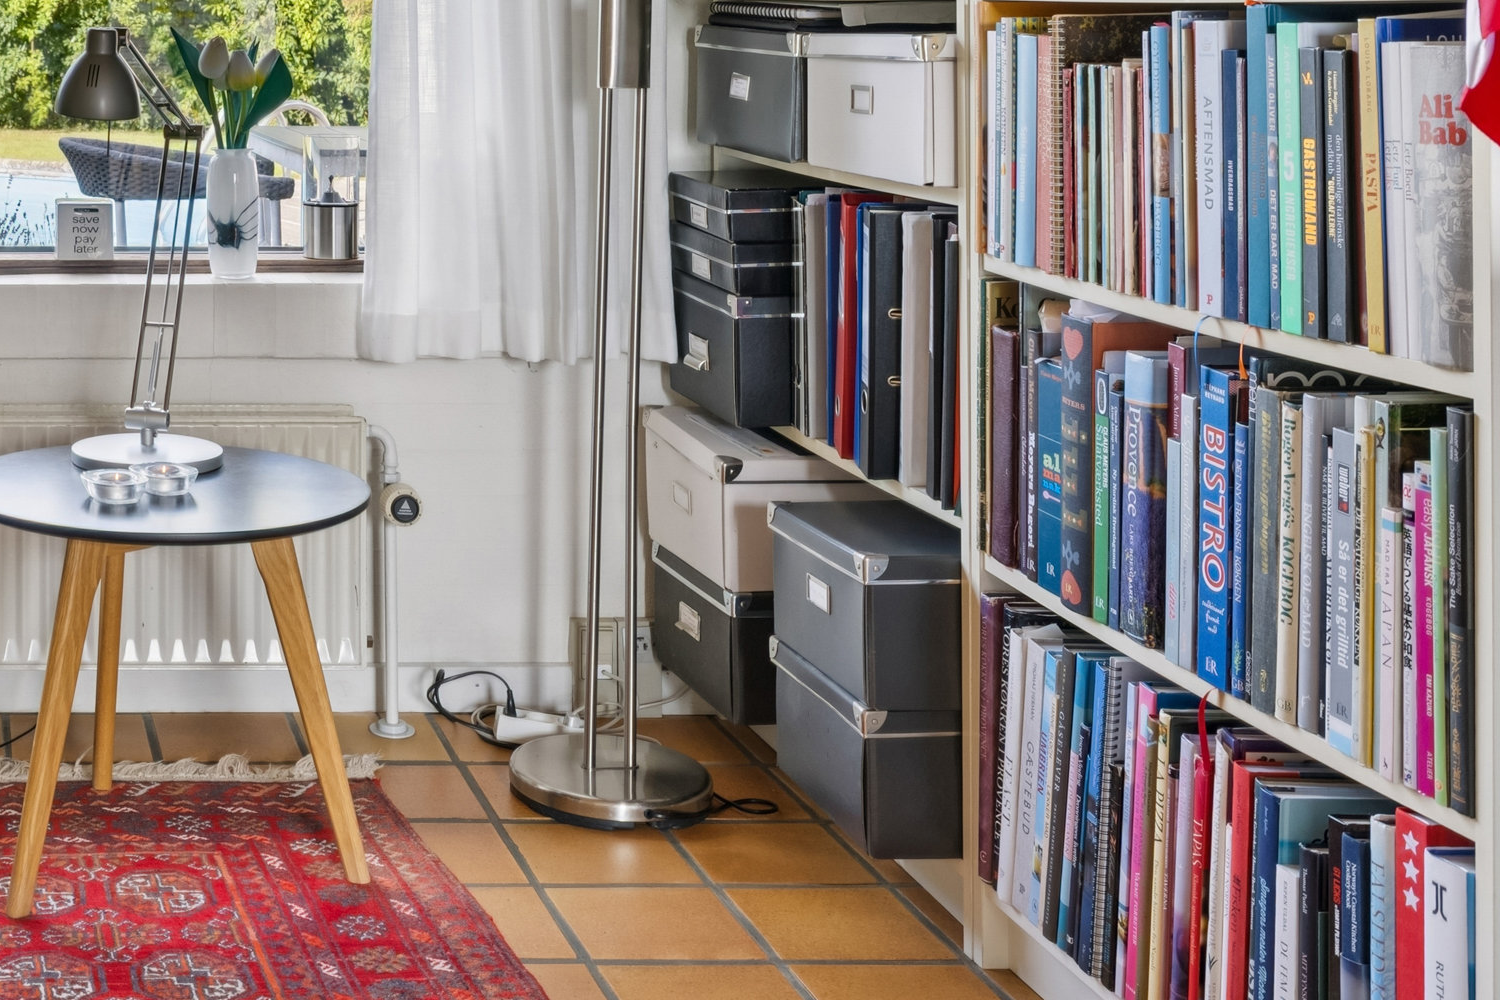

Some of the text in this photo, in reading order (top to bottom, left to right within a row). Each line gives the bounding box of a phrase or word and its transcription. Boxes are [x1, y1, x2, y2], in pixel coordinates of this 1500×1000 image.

[1202, 96, 1215, 210] AFTENSMAD
[1267, 54, 1279, 290] JAMIE OLIVER DET ER MAD
[1327, 133, 1335, 174] madklub
[1403, 142, 1414, 202] Letz Boeuf
[1303, 138, 1317, 246] GASTROMAND
[1334, 133, 1344, 249] den hemmelige italienske
[1364, 152, 1378, 213] PASTA
[72, 215, 99, 224] save
[72, 225, 99, 233] now
[74, 235, 96, 245] pay
[1283, 150, 1297, 282] 5 INGREDIENSER
[73, 244, 98, 254] later
[1027, 337, 1036, 422] Claus Meyer
[1172, 366, 1180, 393] James
[1027, 431, 1036, 548] Meyers Bageri
[1095, 423, 1104, 527] Salatværksted
[1111, 468, 1118, 480] Ny
[1127, 405, 1142, 517] Provence
[1235, 458, 1243, 481] DET
[1338, 465, 1349, 502] weber
[1203, 424, 1227, 592] BISTRO
[1235, 482, 1242, 499] NY
[1422, 498, 1435, 530] easy
[1280, 418, 1296, 626] Roger KOGEBOG
[1301, 502, 1312, 575] ENGELSK
[1234, 555, 1242, 603] KØKKEN
[1423, 531, 1434, 588] JAPANSK
[1448, 504, 1456, 610] The Sake Selection
[1301, 611, 1312, 648] MAD
[1335, 540, 1349, 670] Så er det grilltid
[1380, 590, 1393, 670] JAPAN
[1231, 678, 1244, 693] GB
[994, 625, 1011, 843] VORES KØKKEN PROVENCE
[1053, 710, 1067, 793] GÅSELEVER
[1002, 755, 1014, 828] FEAST
[1020, 740, 1036, 836] GÆSTEBUD
[1037, 730, 1048, 797] UMBRIEN
[1426, 751, 1434, 781] ATELIER
[1153, 788, 1165, 845] PIZZA
[1191, 817, 1204, 867] TAPAS
[1258, 874, 1270, 928] Smagens
[1350, 861, 1358, 896] Norway's
[1131, 871, 1141, 947] VARME FORRETTER
[1350, 896, 1358, 924] Coastal
[1279, 940, 1290, 994] DE FEM
[1300, 951, 1309, 972] MIT
